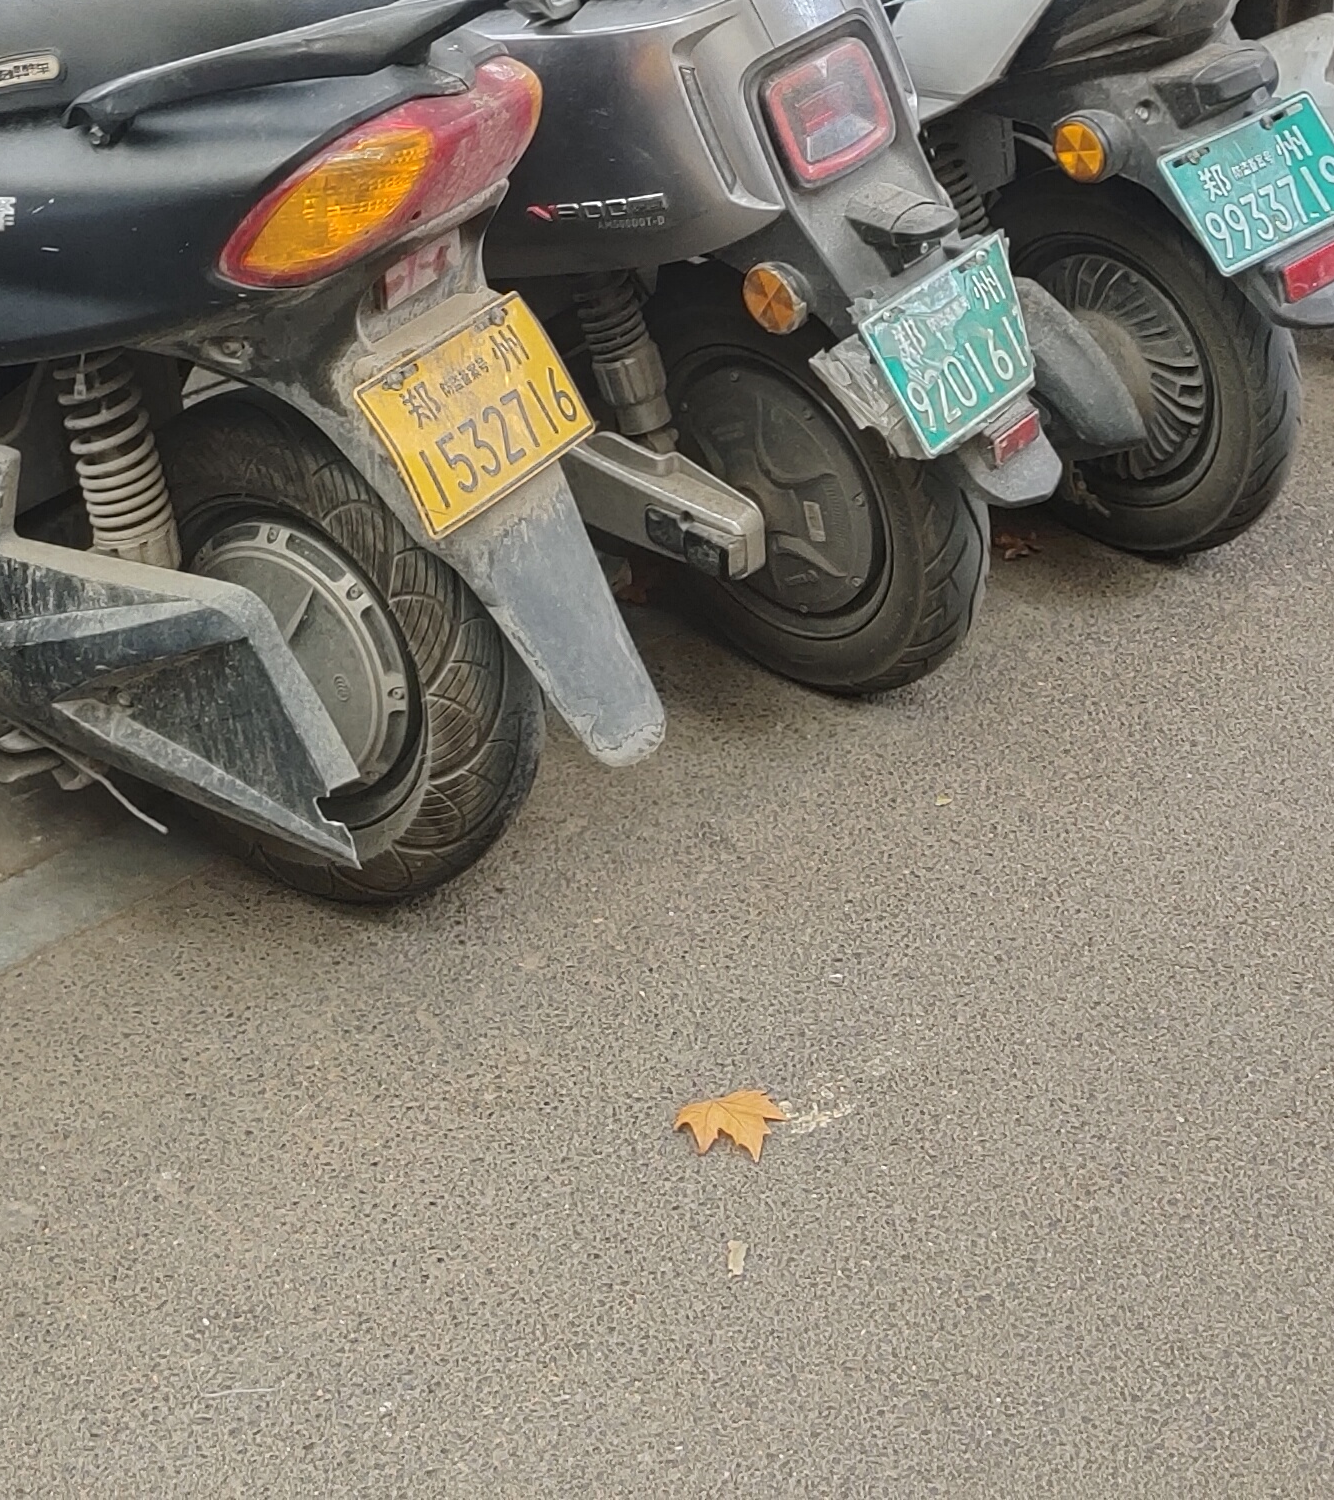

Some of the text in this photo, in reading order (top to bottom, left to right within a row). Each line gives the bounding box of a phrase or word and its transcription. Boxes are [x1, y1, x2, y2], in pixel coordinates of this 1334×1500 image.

[1197, 163, 1232, 202] 郑
[1275, 125, 1313, 167] 州
[972, 265, 1006, 311] 州
[399, 381, 442, 430] 郑
[491, 323, 530, 373] 州
[419, 366, 578, 510] 1532716
